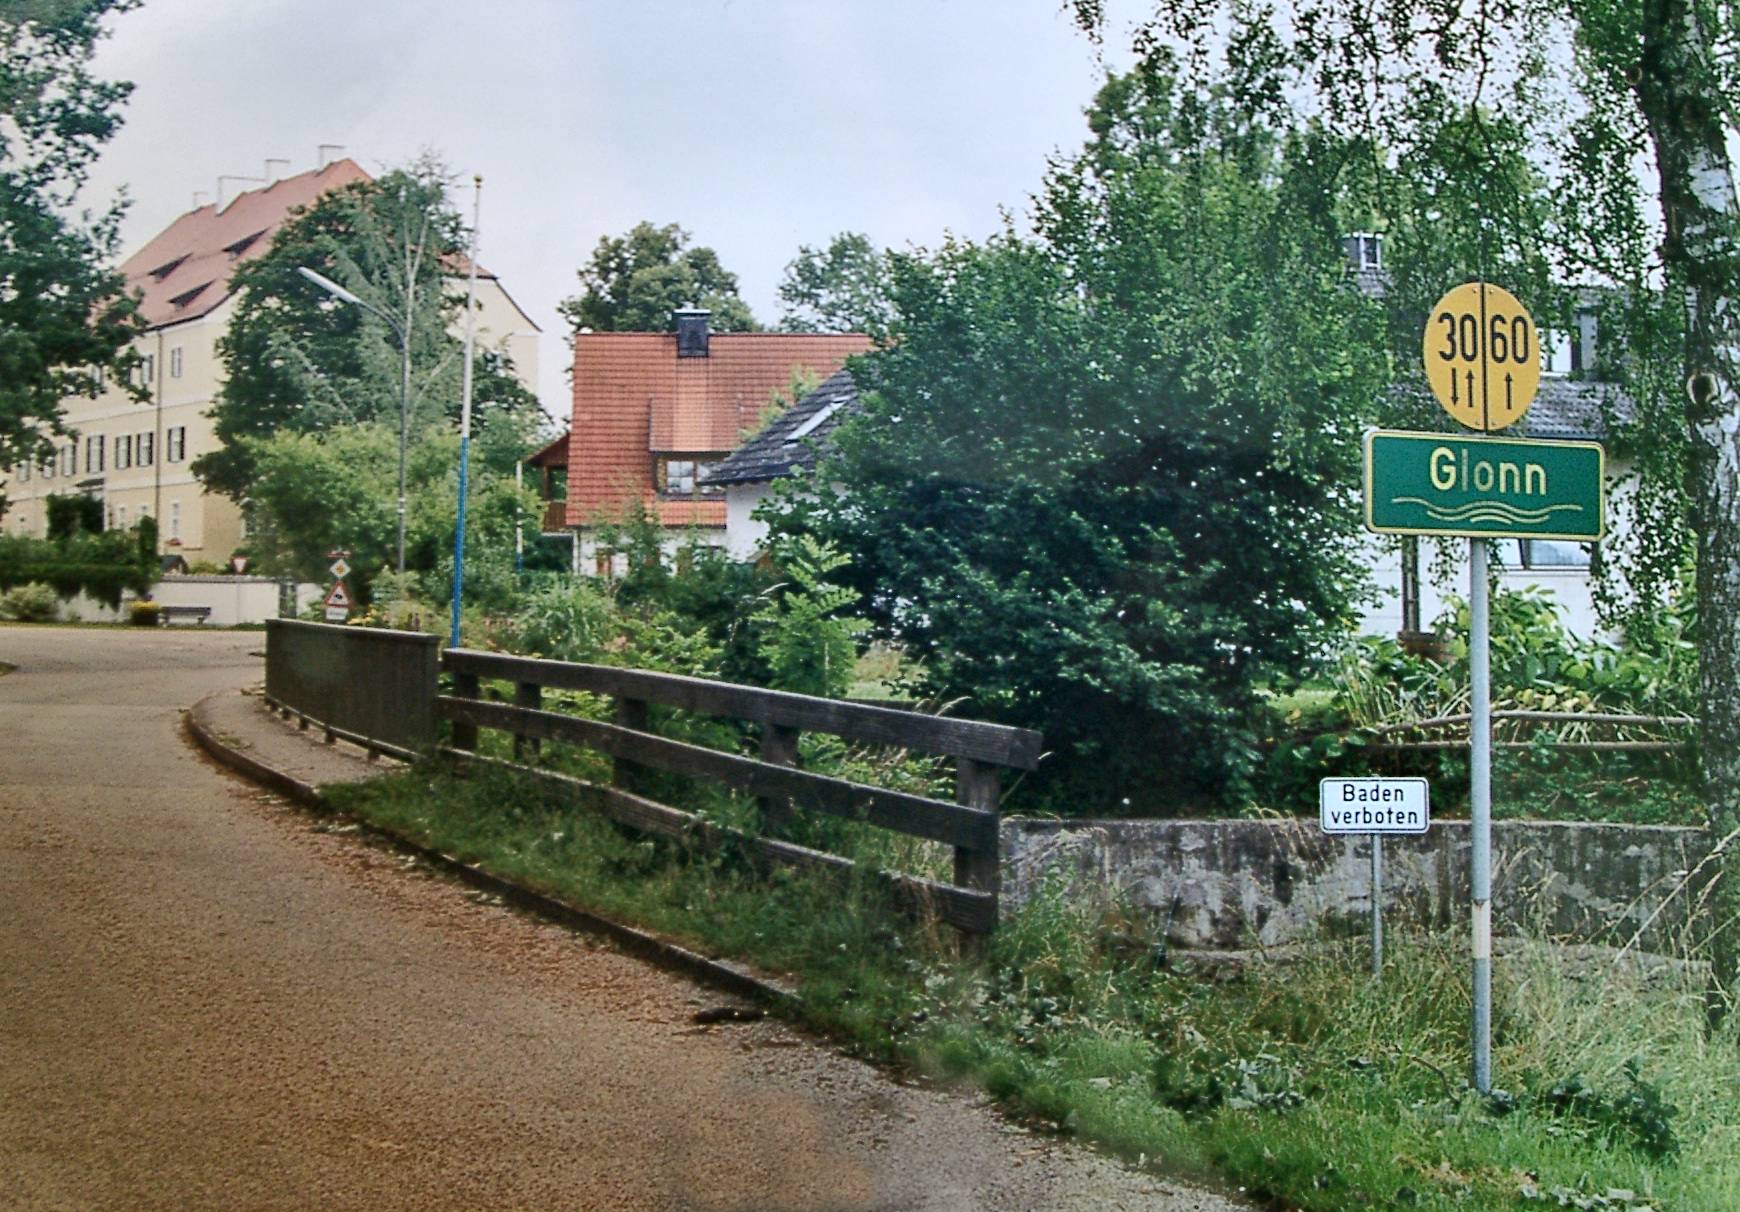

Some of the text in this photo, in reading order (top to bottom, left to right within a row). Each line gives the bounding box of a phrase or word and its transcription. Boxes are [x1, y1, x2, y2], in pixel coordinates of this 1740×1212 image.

[1438, 312, 1477, 362] 30
[1490, 313, 1529, 364] 60
[1430, 447, 1547, 495] Glonn
[1331, 806, 1418, 825] verboten
[1343, 783, 1404, 802] Baden
